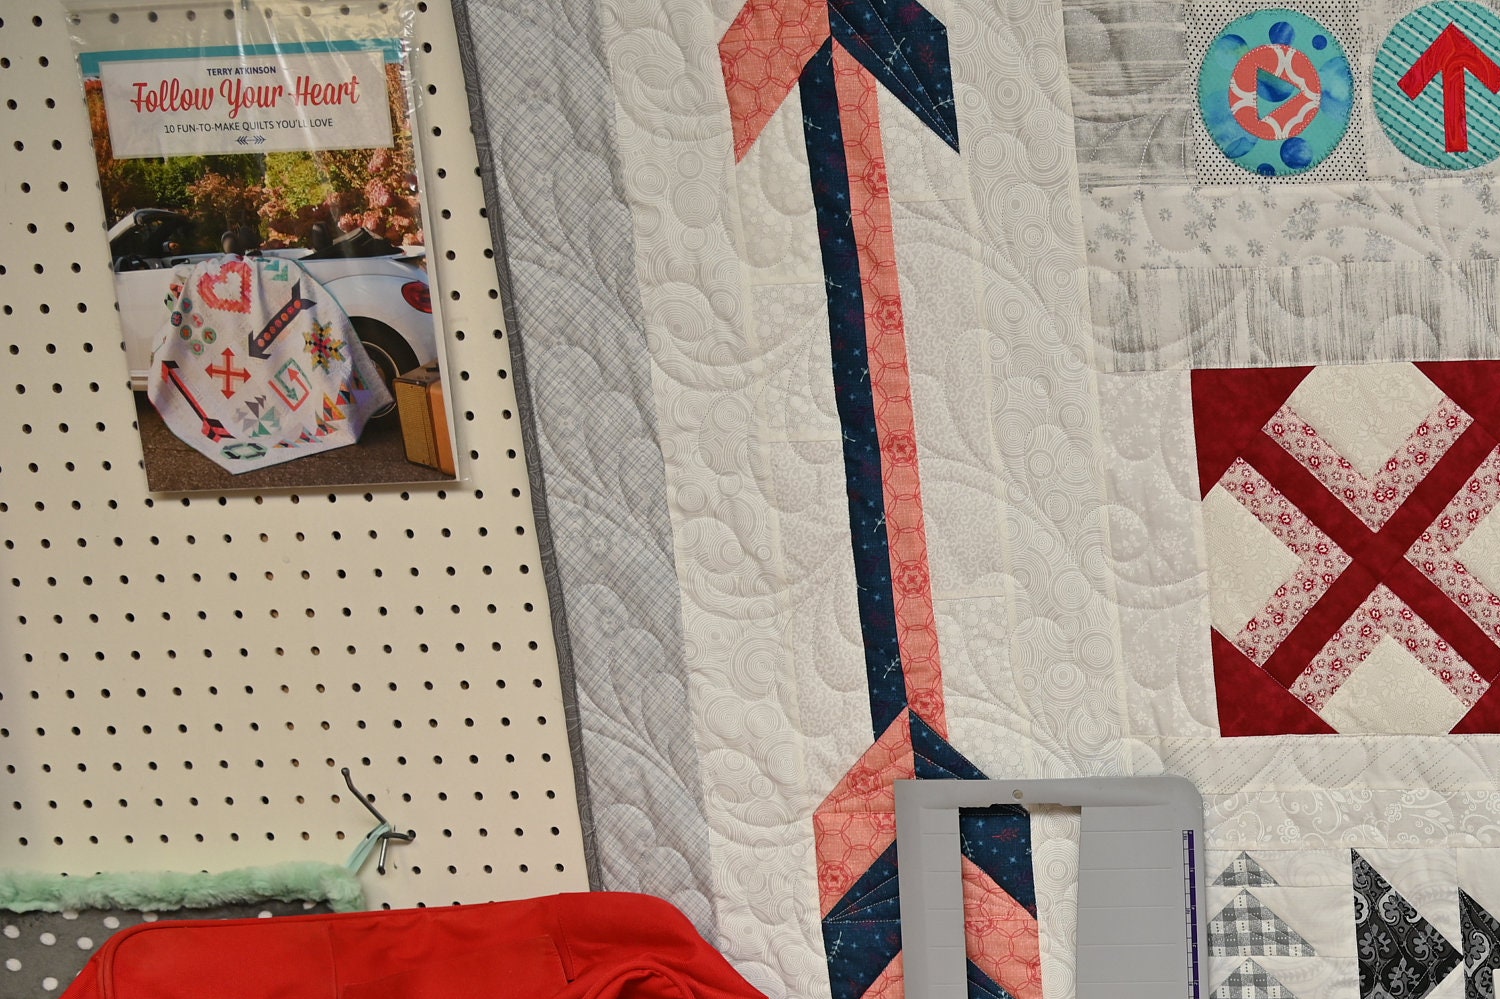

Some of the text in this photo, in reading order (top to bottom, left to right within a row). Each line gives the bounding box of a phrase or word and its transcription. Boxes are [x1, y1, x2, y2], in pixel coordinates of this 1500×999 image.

[207, 66, 277, 77] TERRY ATKINSON
[130, 75, 360, 119] Follow Your Heart
[164, 118, 333, 134] 10 FUN-TO-MAKE QUILTS YOU'LL LOVE
